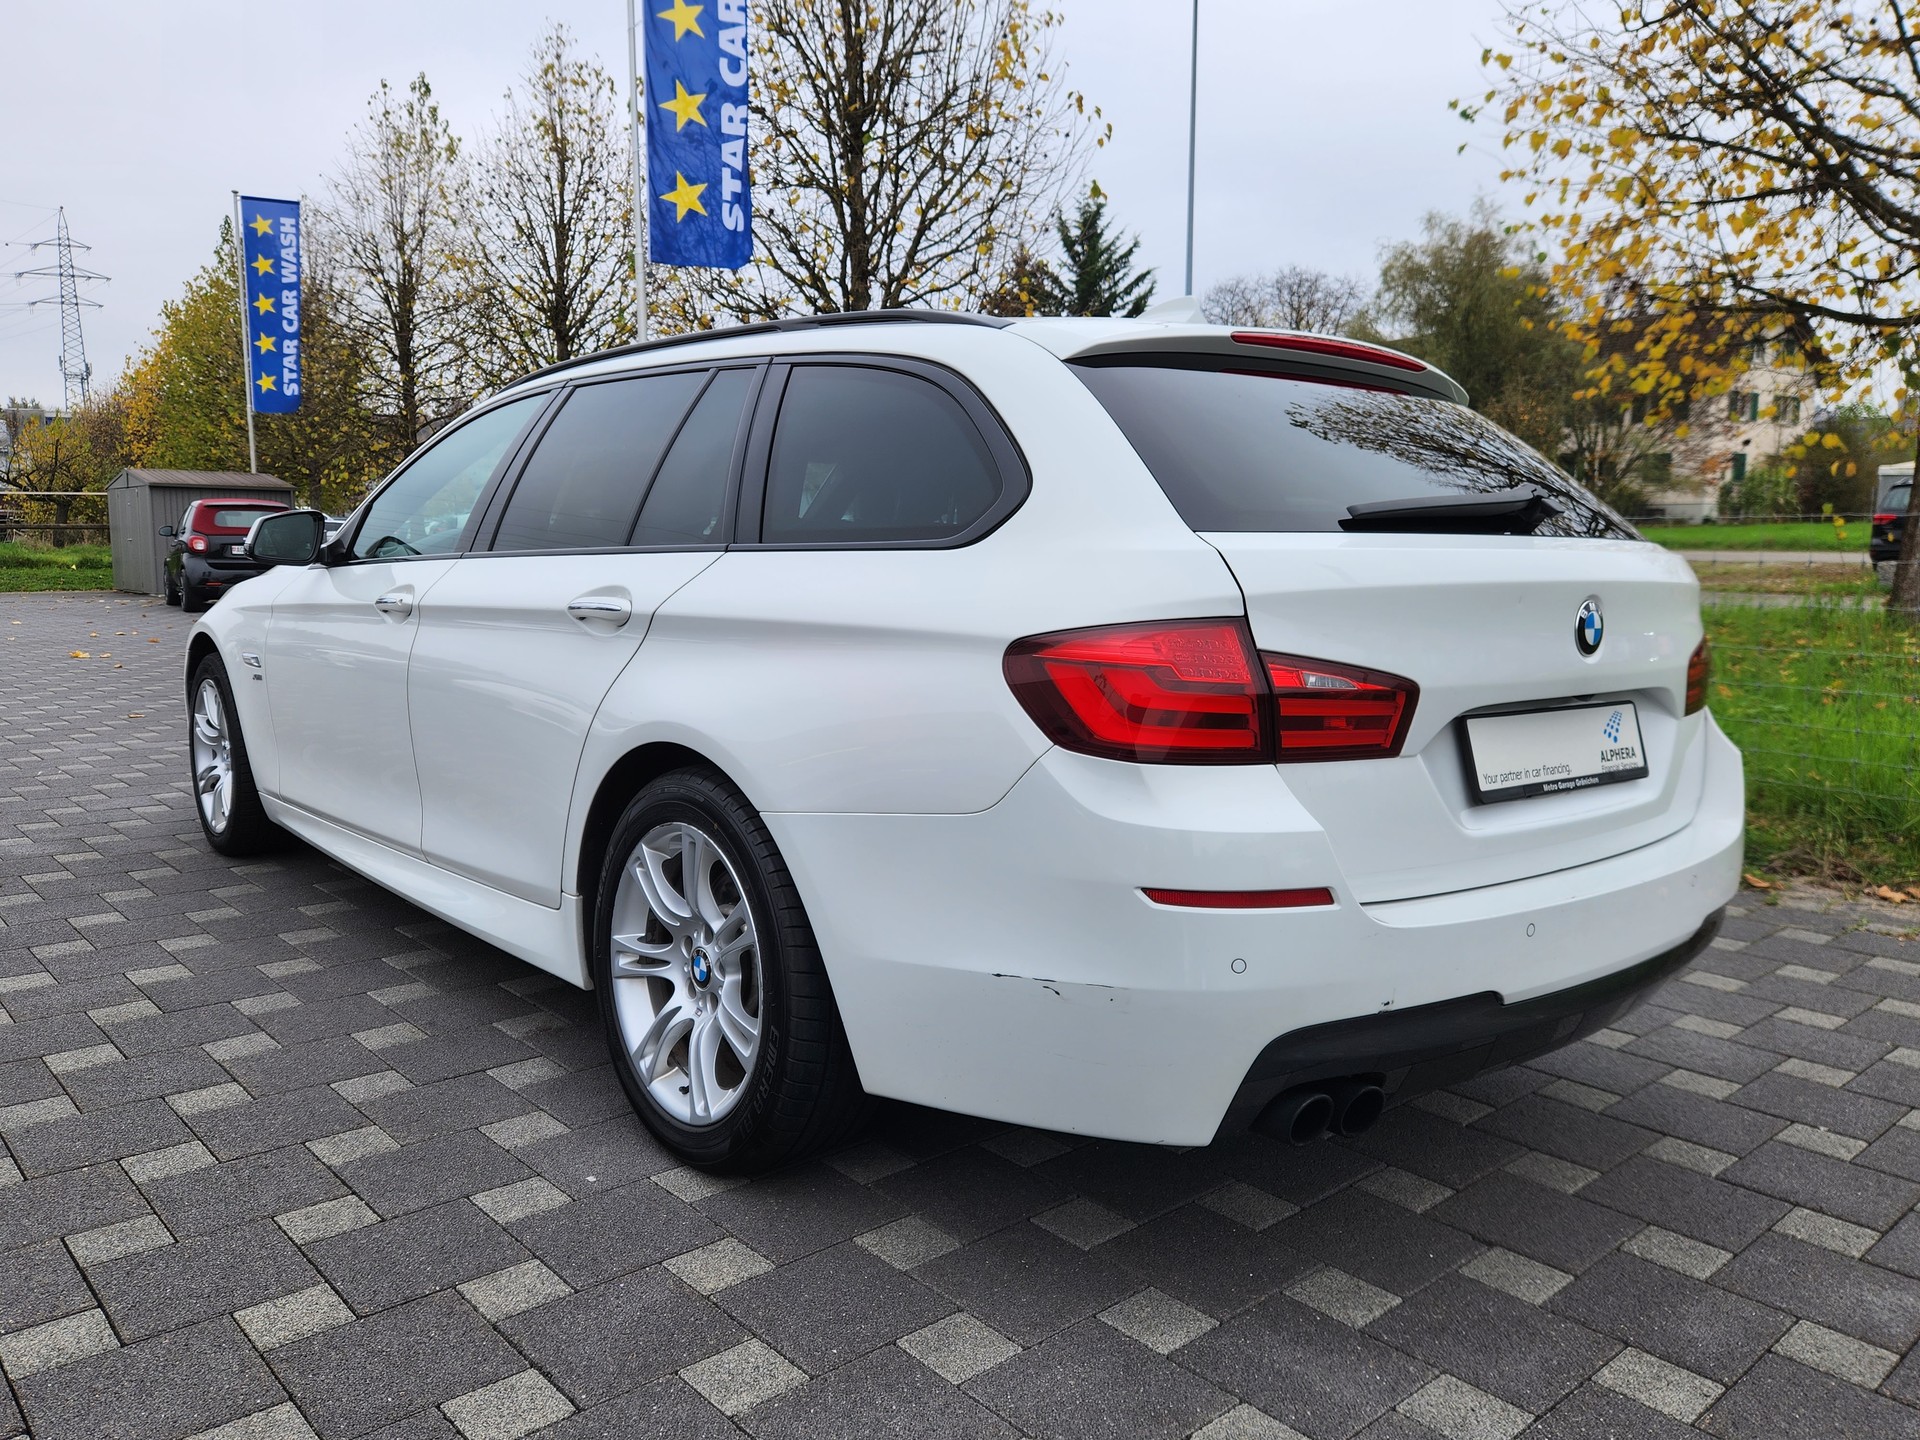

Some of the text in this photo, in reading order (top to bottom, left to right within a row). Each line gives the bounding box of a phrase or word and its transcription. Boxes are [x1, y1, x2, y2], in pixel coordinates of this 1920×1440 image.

[718, 0, 747, 232] STAR CAR
[280, 216, 299, 396] STAR CAR WASH
[1483, 763, 1572, 785] Your partner in car financing.
[1600, 747, 1637, 763] ALPHERA
